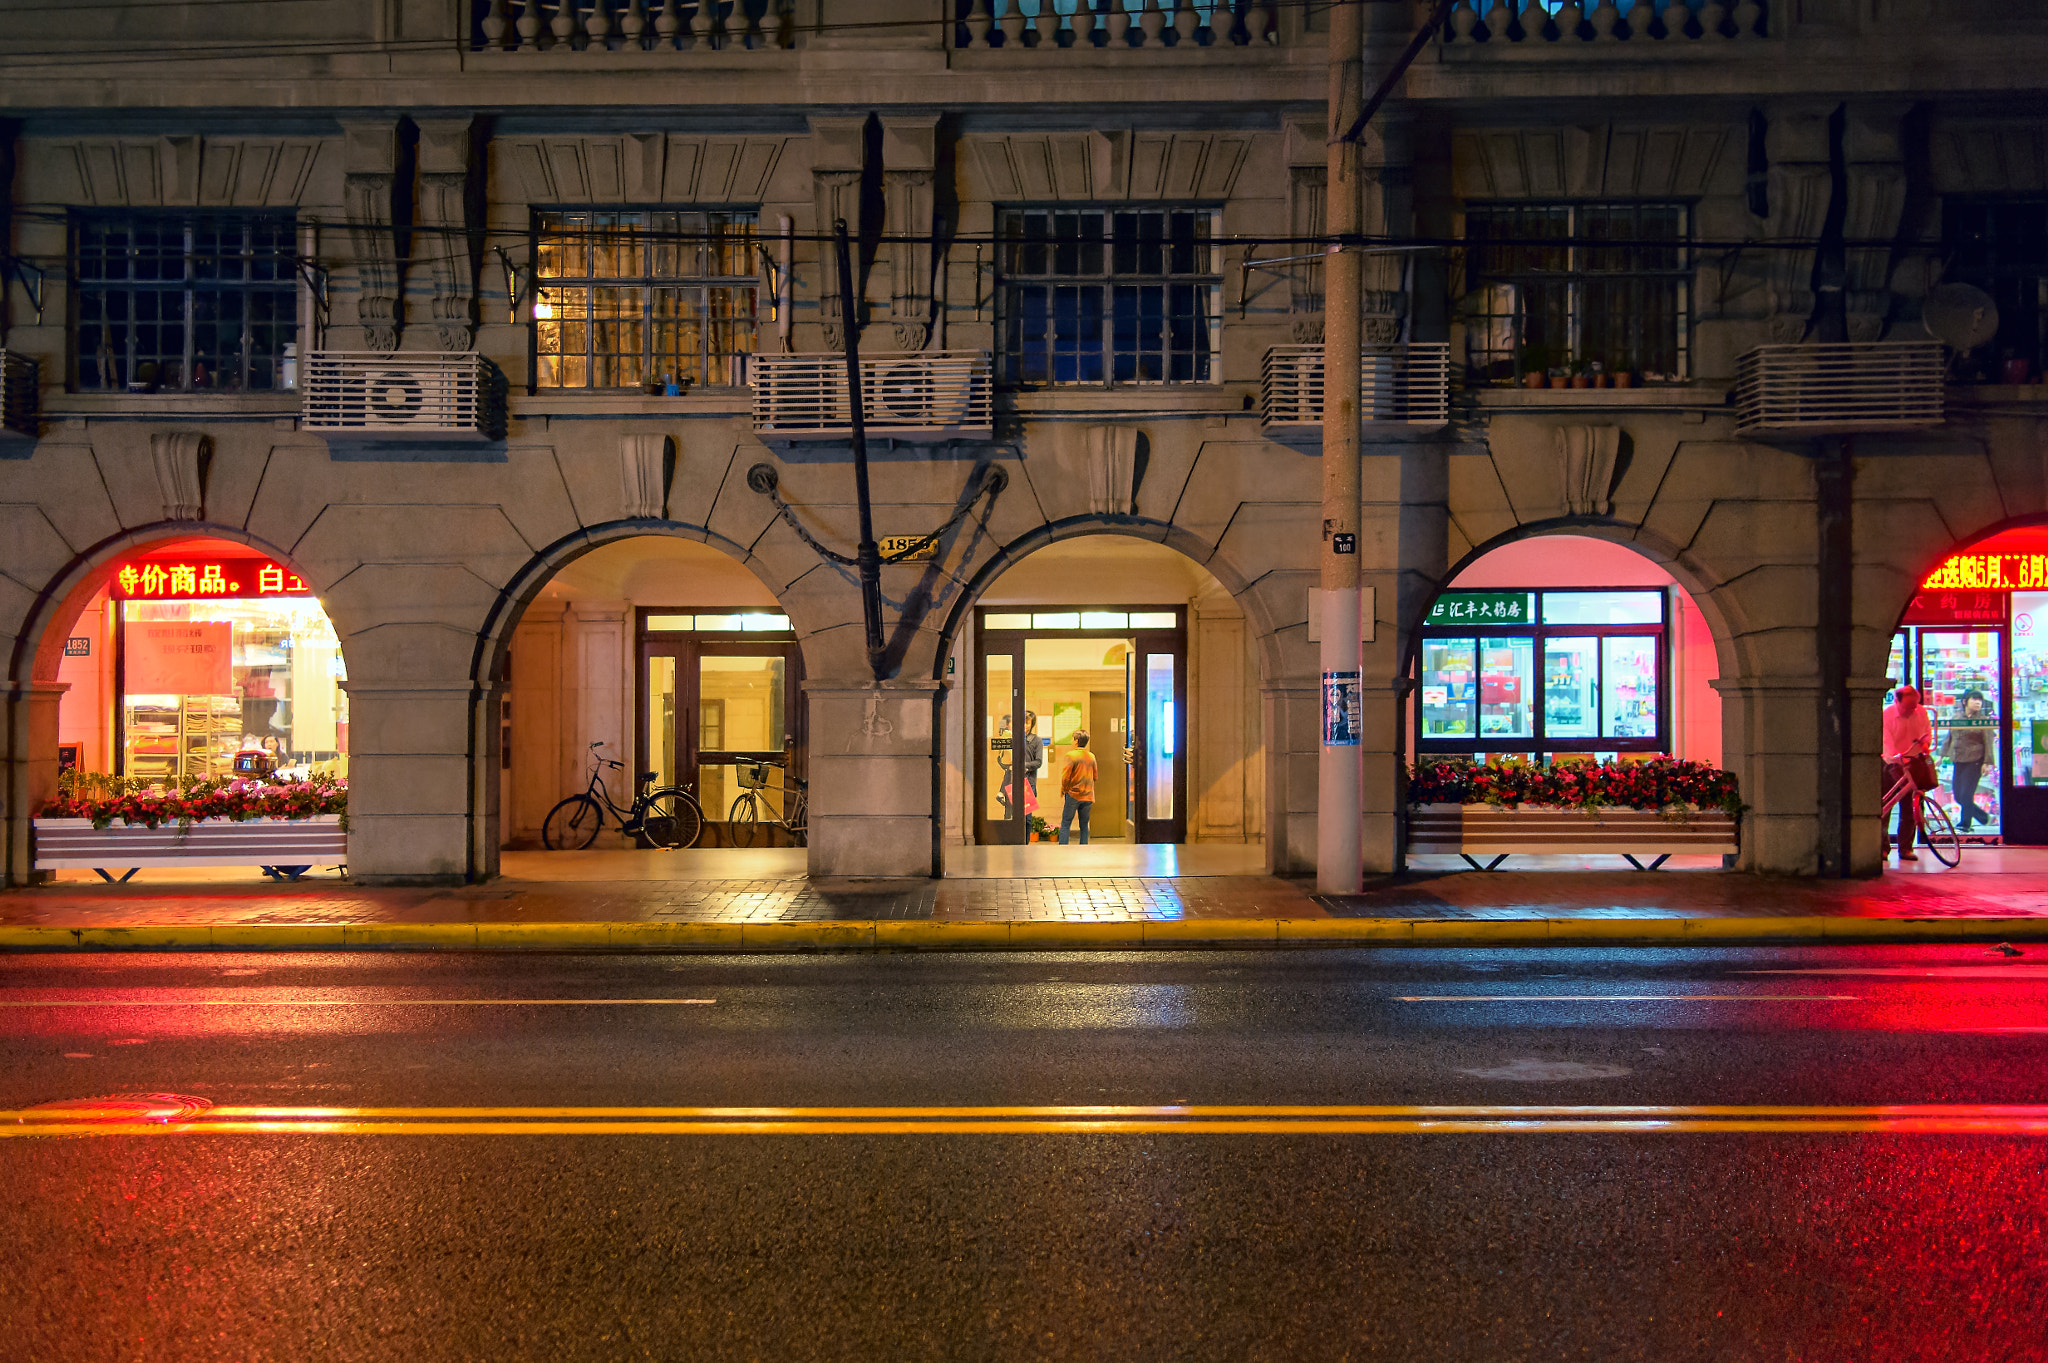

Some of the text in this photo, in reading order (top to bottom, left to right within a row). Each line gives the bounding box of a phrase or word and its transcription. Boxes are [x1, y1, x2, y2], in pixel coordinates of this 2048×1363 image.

[1339, 543, 1351, 552] 100
[1449, 601, 1522, 618] 汇丰大药房
[67, 639, 88, 650] 1852
